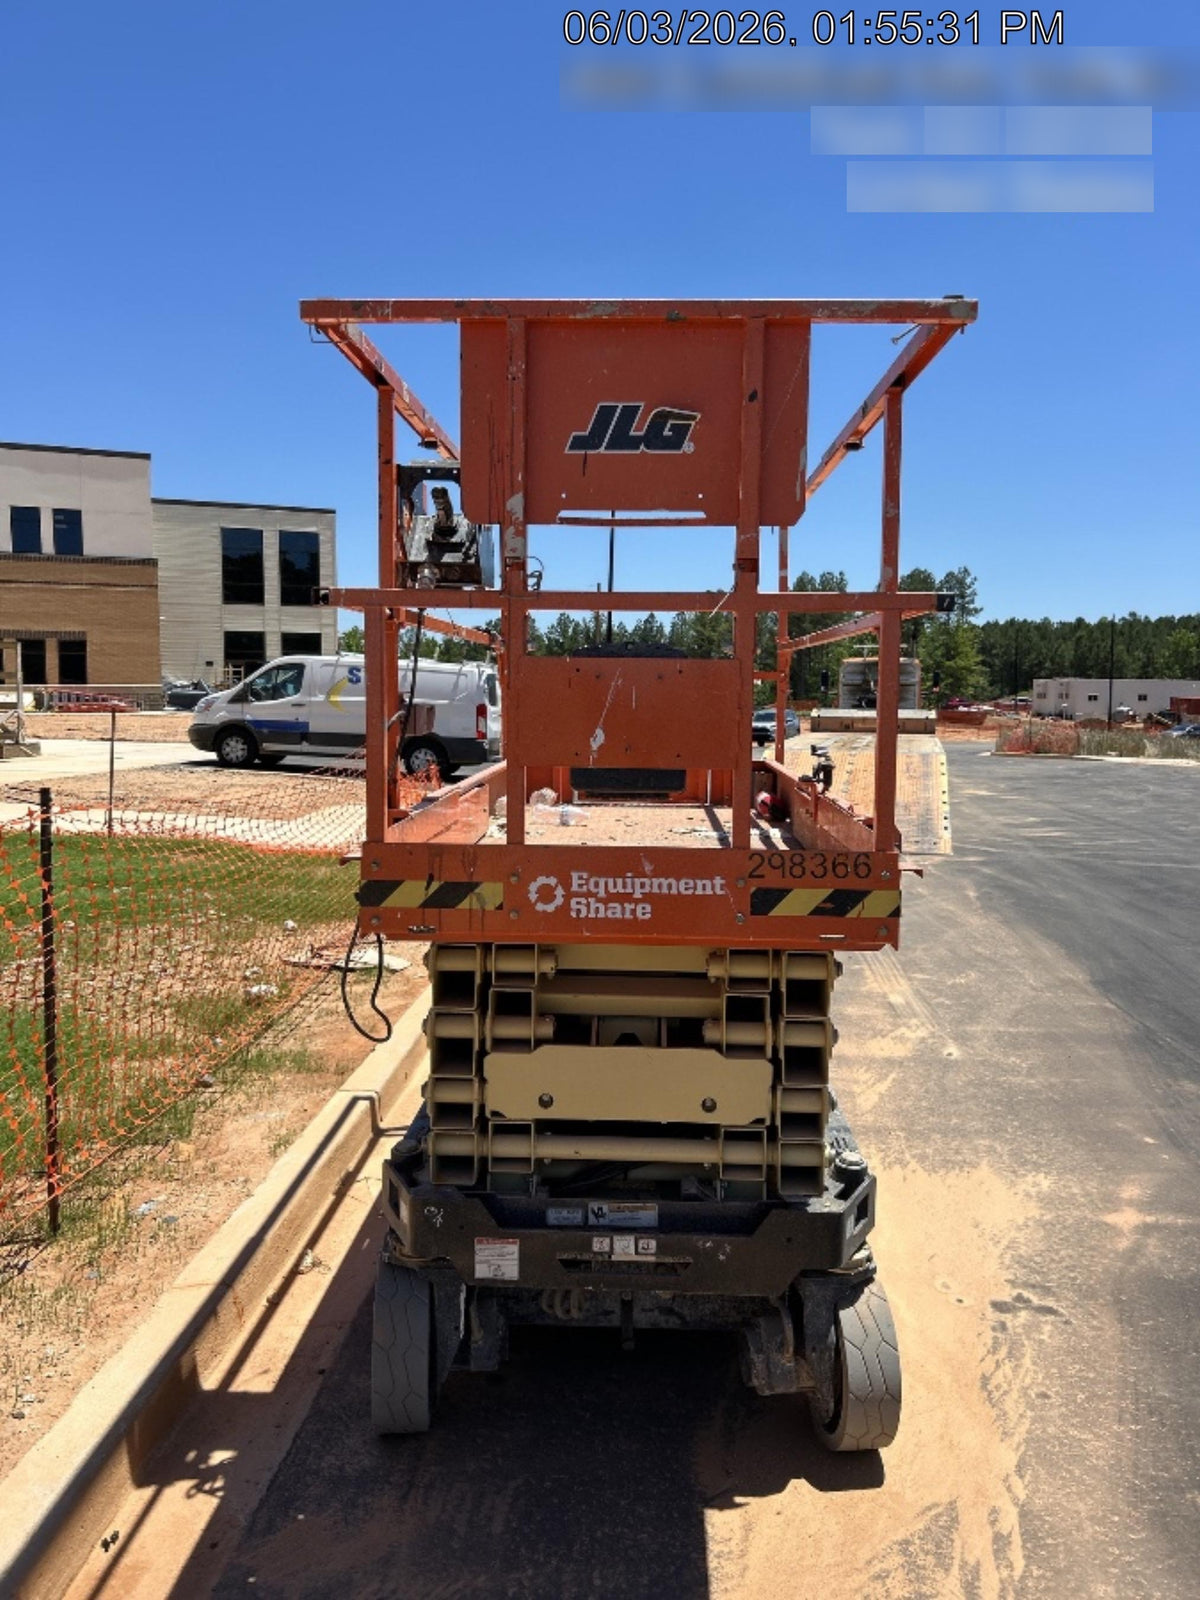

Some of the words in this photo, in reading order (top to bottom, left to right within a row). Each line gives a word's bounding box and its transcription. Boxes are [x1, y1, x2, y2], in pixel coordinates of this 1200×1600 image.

[565, 402, 701, 455] JLG
[748, 852, 872, 879] 298366
[570, 871, 726, 898] Equipment
[570, 897, 652, 919] Share
